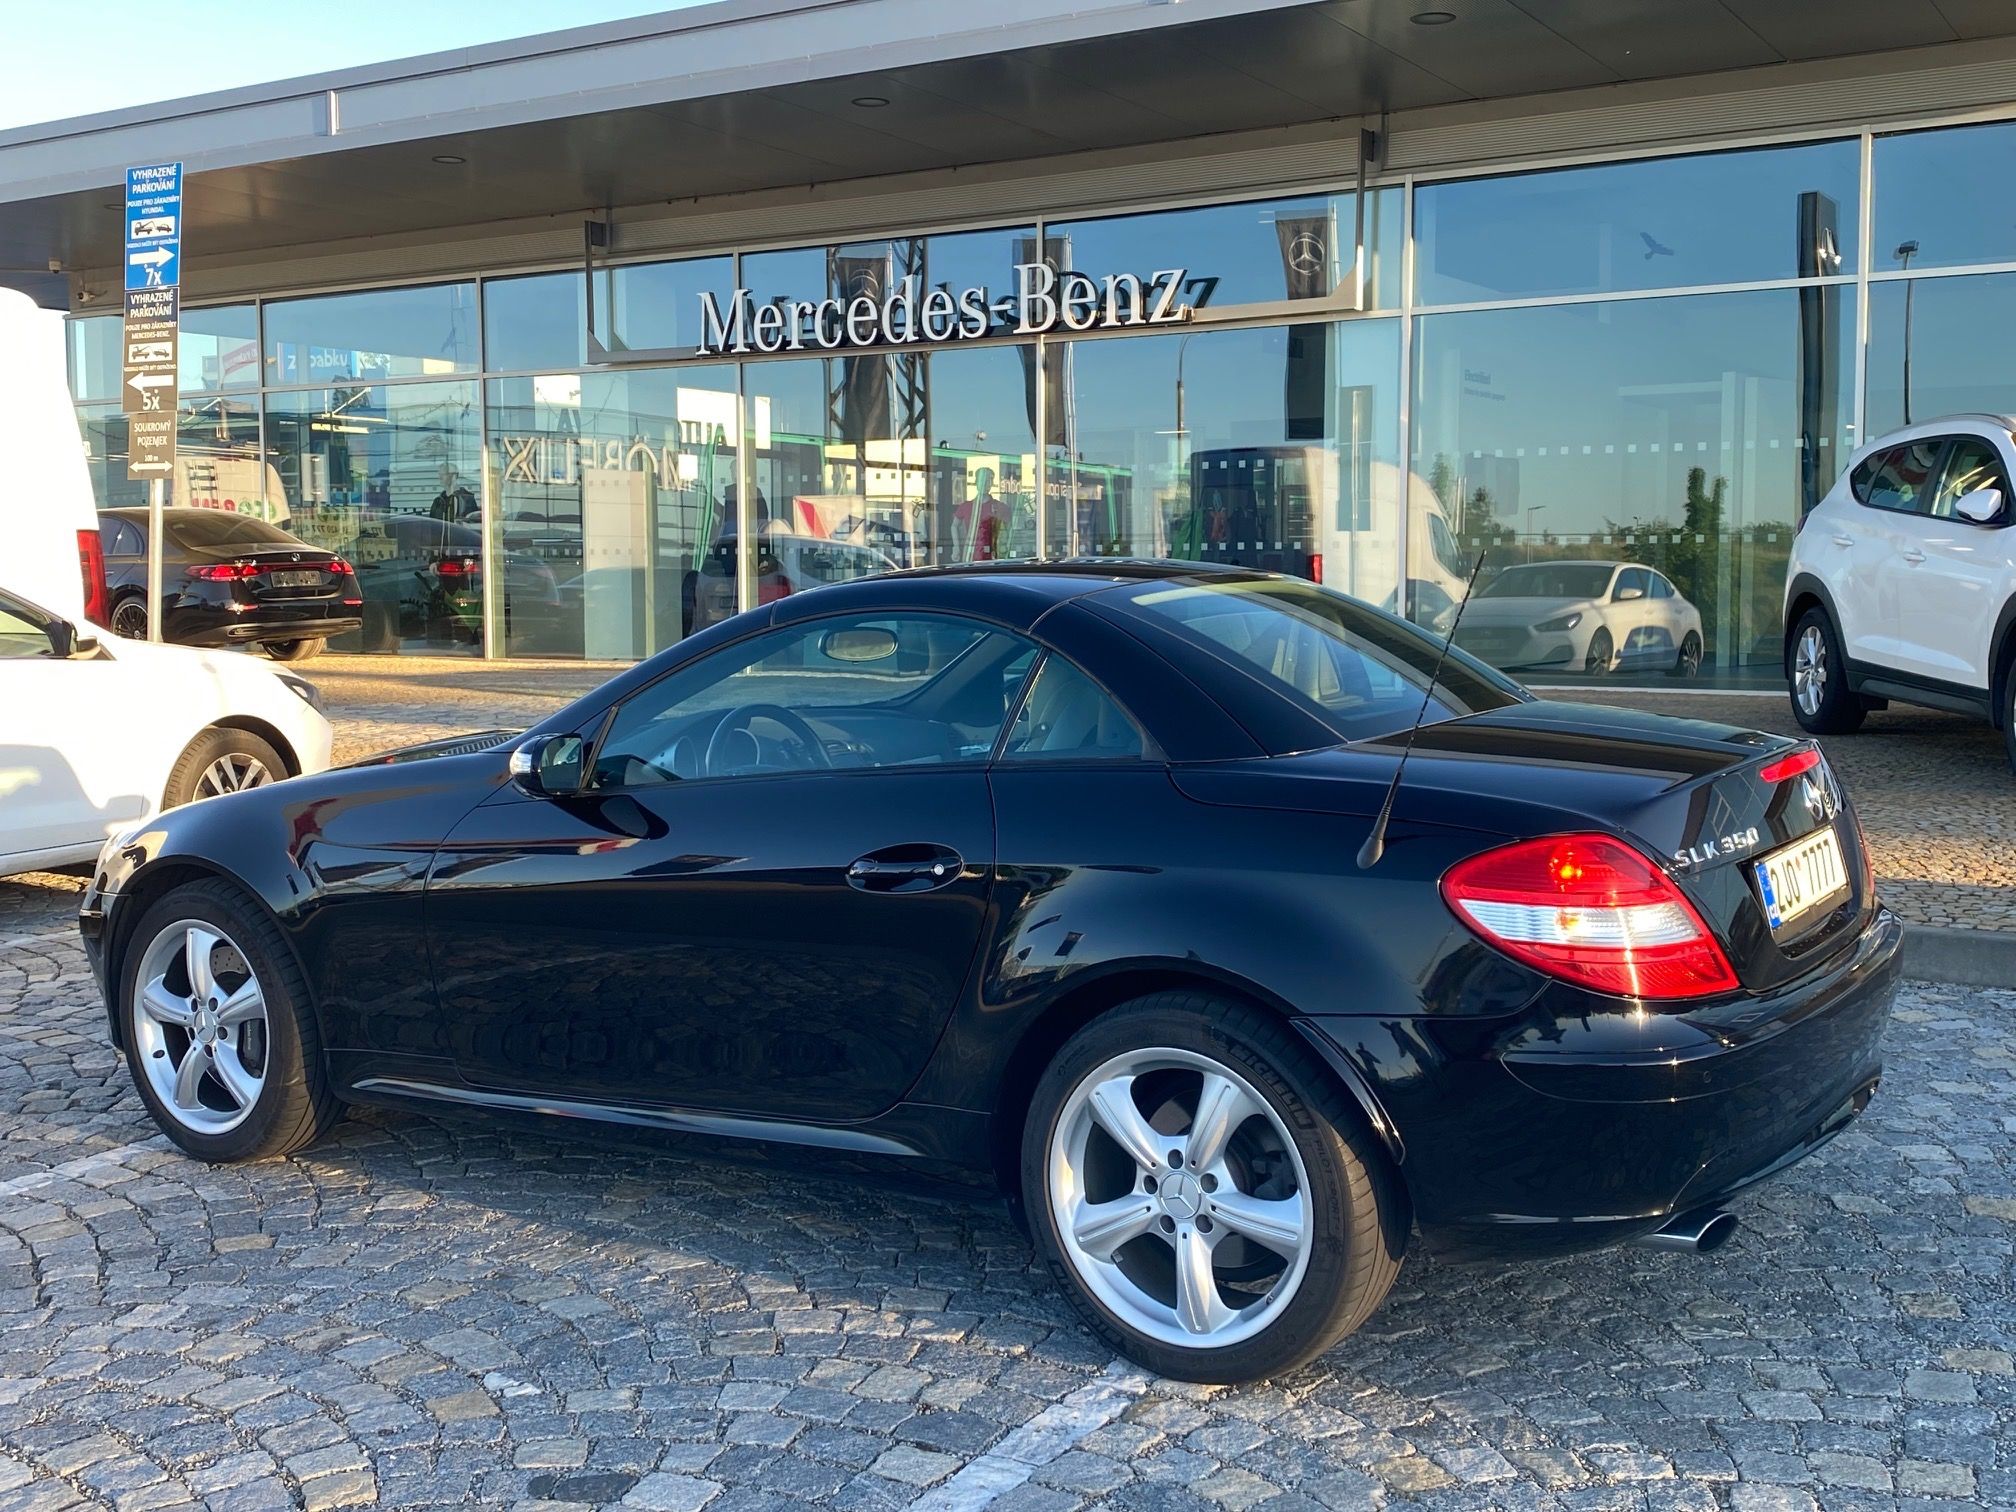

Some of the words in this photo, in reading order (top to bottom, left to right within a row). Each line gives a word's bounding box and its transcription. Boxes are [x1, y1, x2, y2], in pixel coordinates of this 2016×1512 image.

[132, 164, 177, 181] VYHRAZENÉ
[132, 178, 175, 194] PARKOVÁNÍ
[130, 289, 174, 306] VYHRAZENÉ
[130, 303, 173, 319] PARKOVÁNÍ
[696, 262, 1188, 357] Mercedes-Benz
[142, 392, 160, 410] 5x
[1674, 839, 1721, 868] SLK
[1721, 827, 1760, 854] 350
